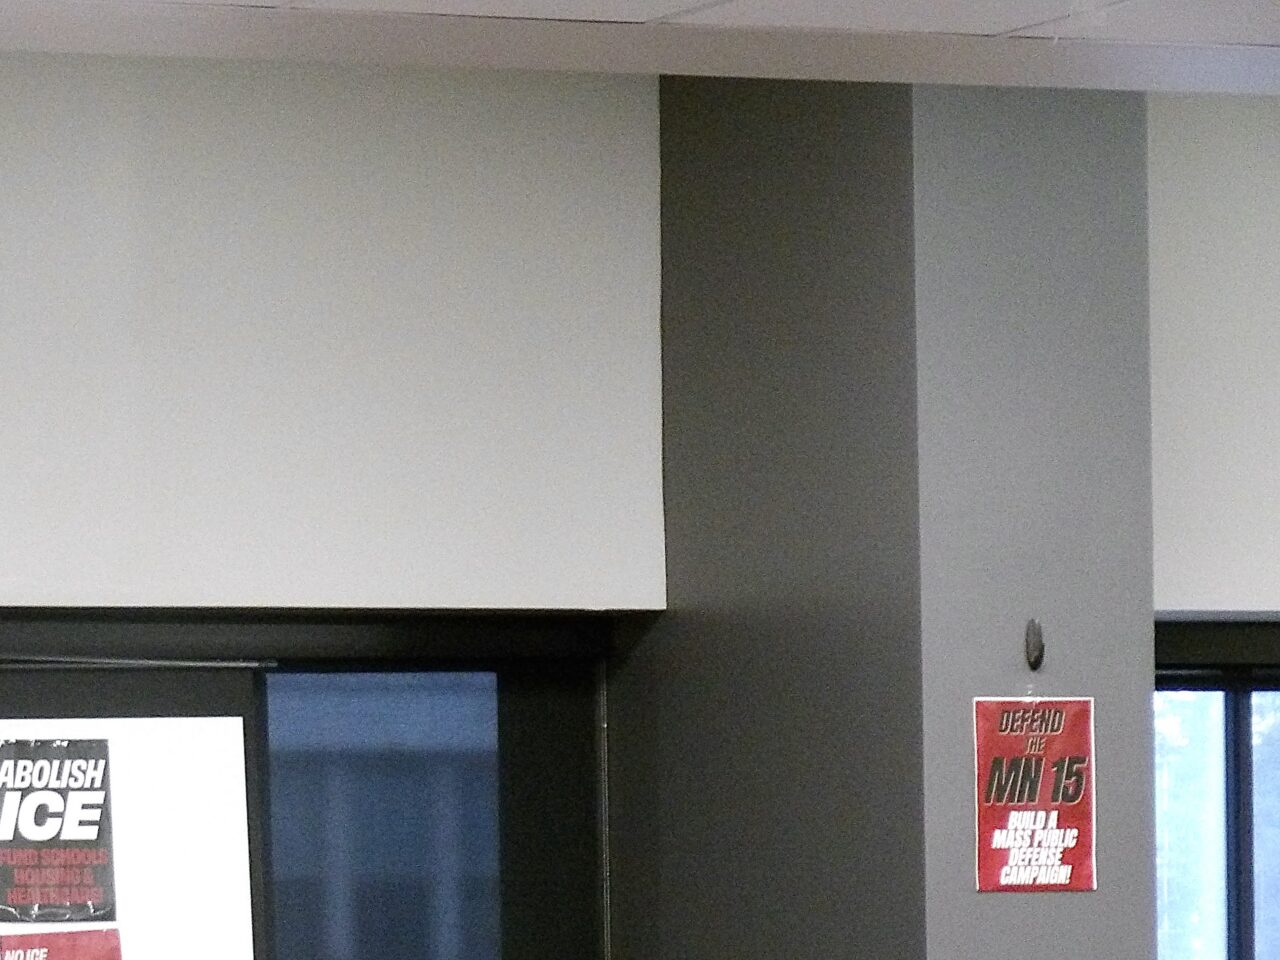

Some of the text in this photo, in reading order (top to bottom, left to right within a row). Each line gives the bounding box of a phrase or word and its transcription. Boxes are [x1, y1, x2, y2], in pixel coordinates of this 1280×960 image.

[998, 709, 1065, 735] DEFEND
[1025, 736, 1047, 754] THE
[985, 756, 1089, 805] MN 15
[1008, 811, 1059, 830] BUILD A
[992, 829, 1078, 849] MASS PUBLIC
[1008, 848, 1064, 867] DEFENSE
[1000, 865, 1073, 885] CAMPAIGN!
